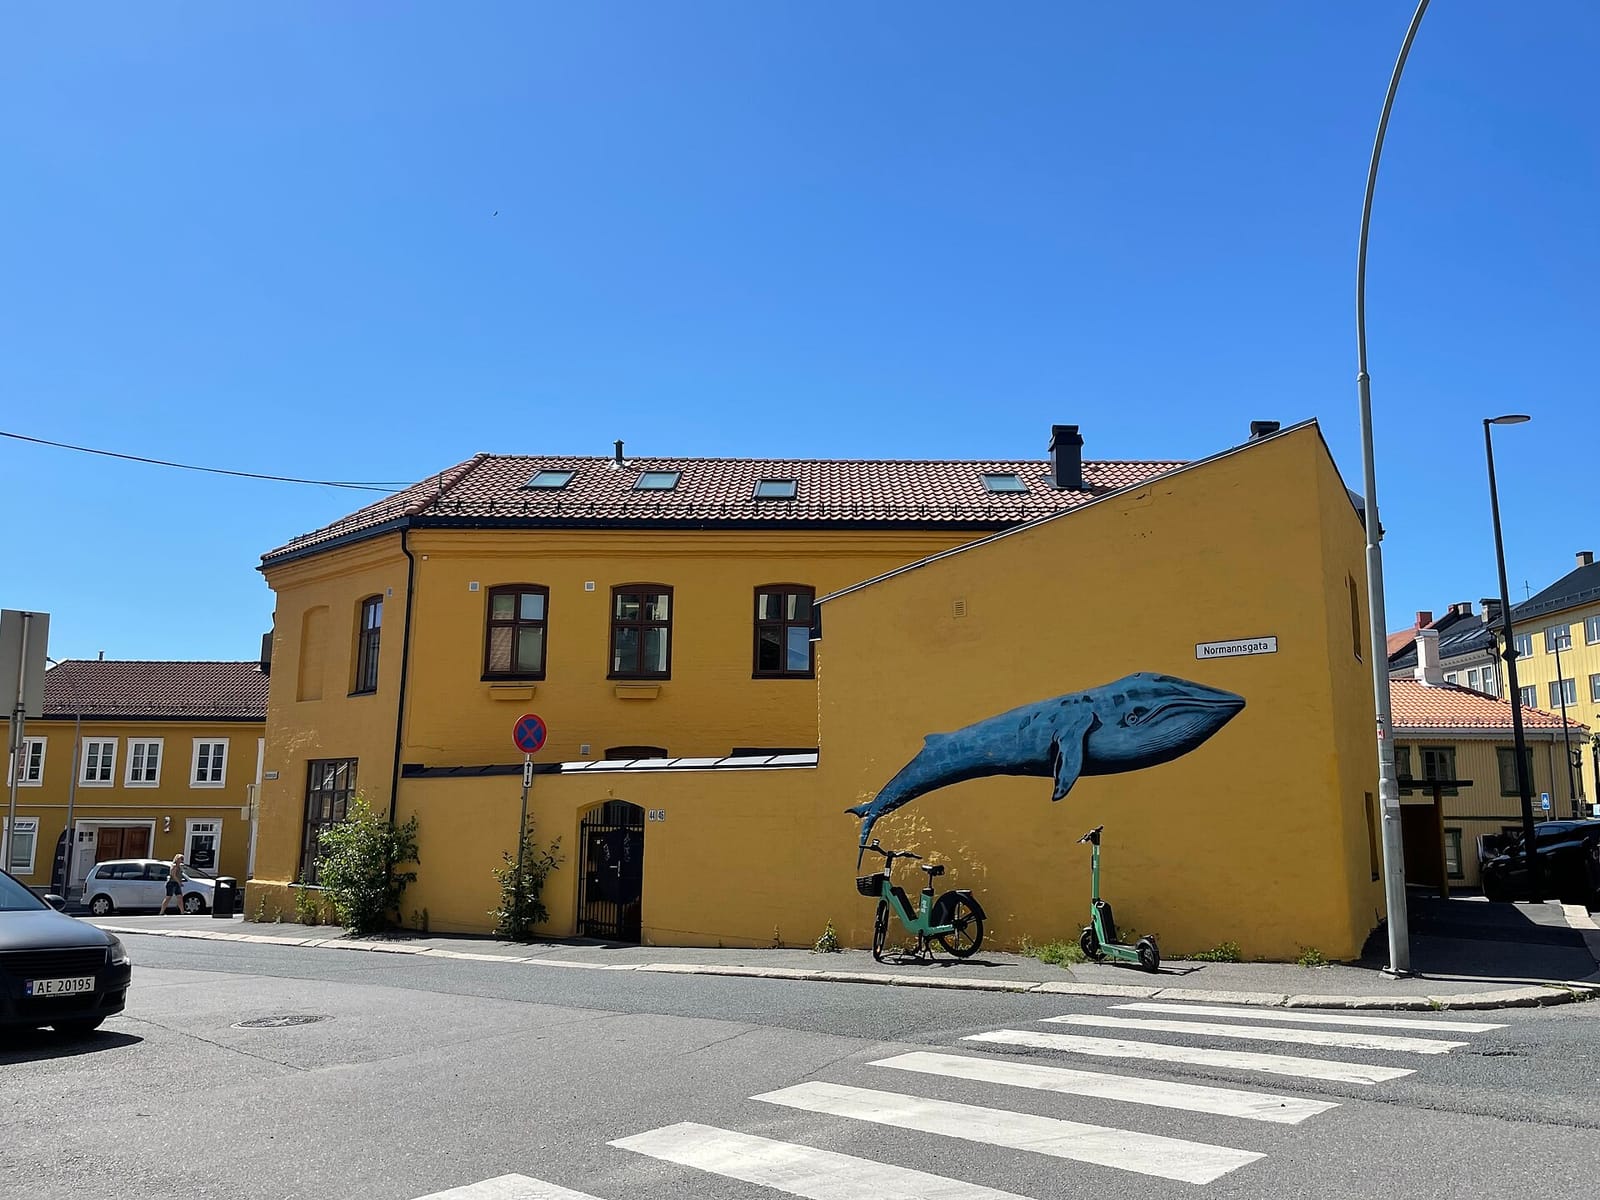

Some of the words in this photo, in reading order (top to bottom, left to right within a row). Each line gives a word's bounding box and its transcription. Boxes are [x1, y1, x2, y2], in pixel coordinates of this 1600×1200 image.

[1203, 642, 1268, 655] Normannsgata
[37, 981, 52, 993] AE
[57, 979, 91, 992] 20195
